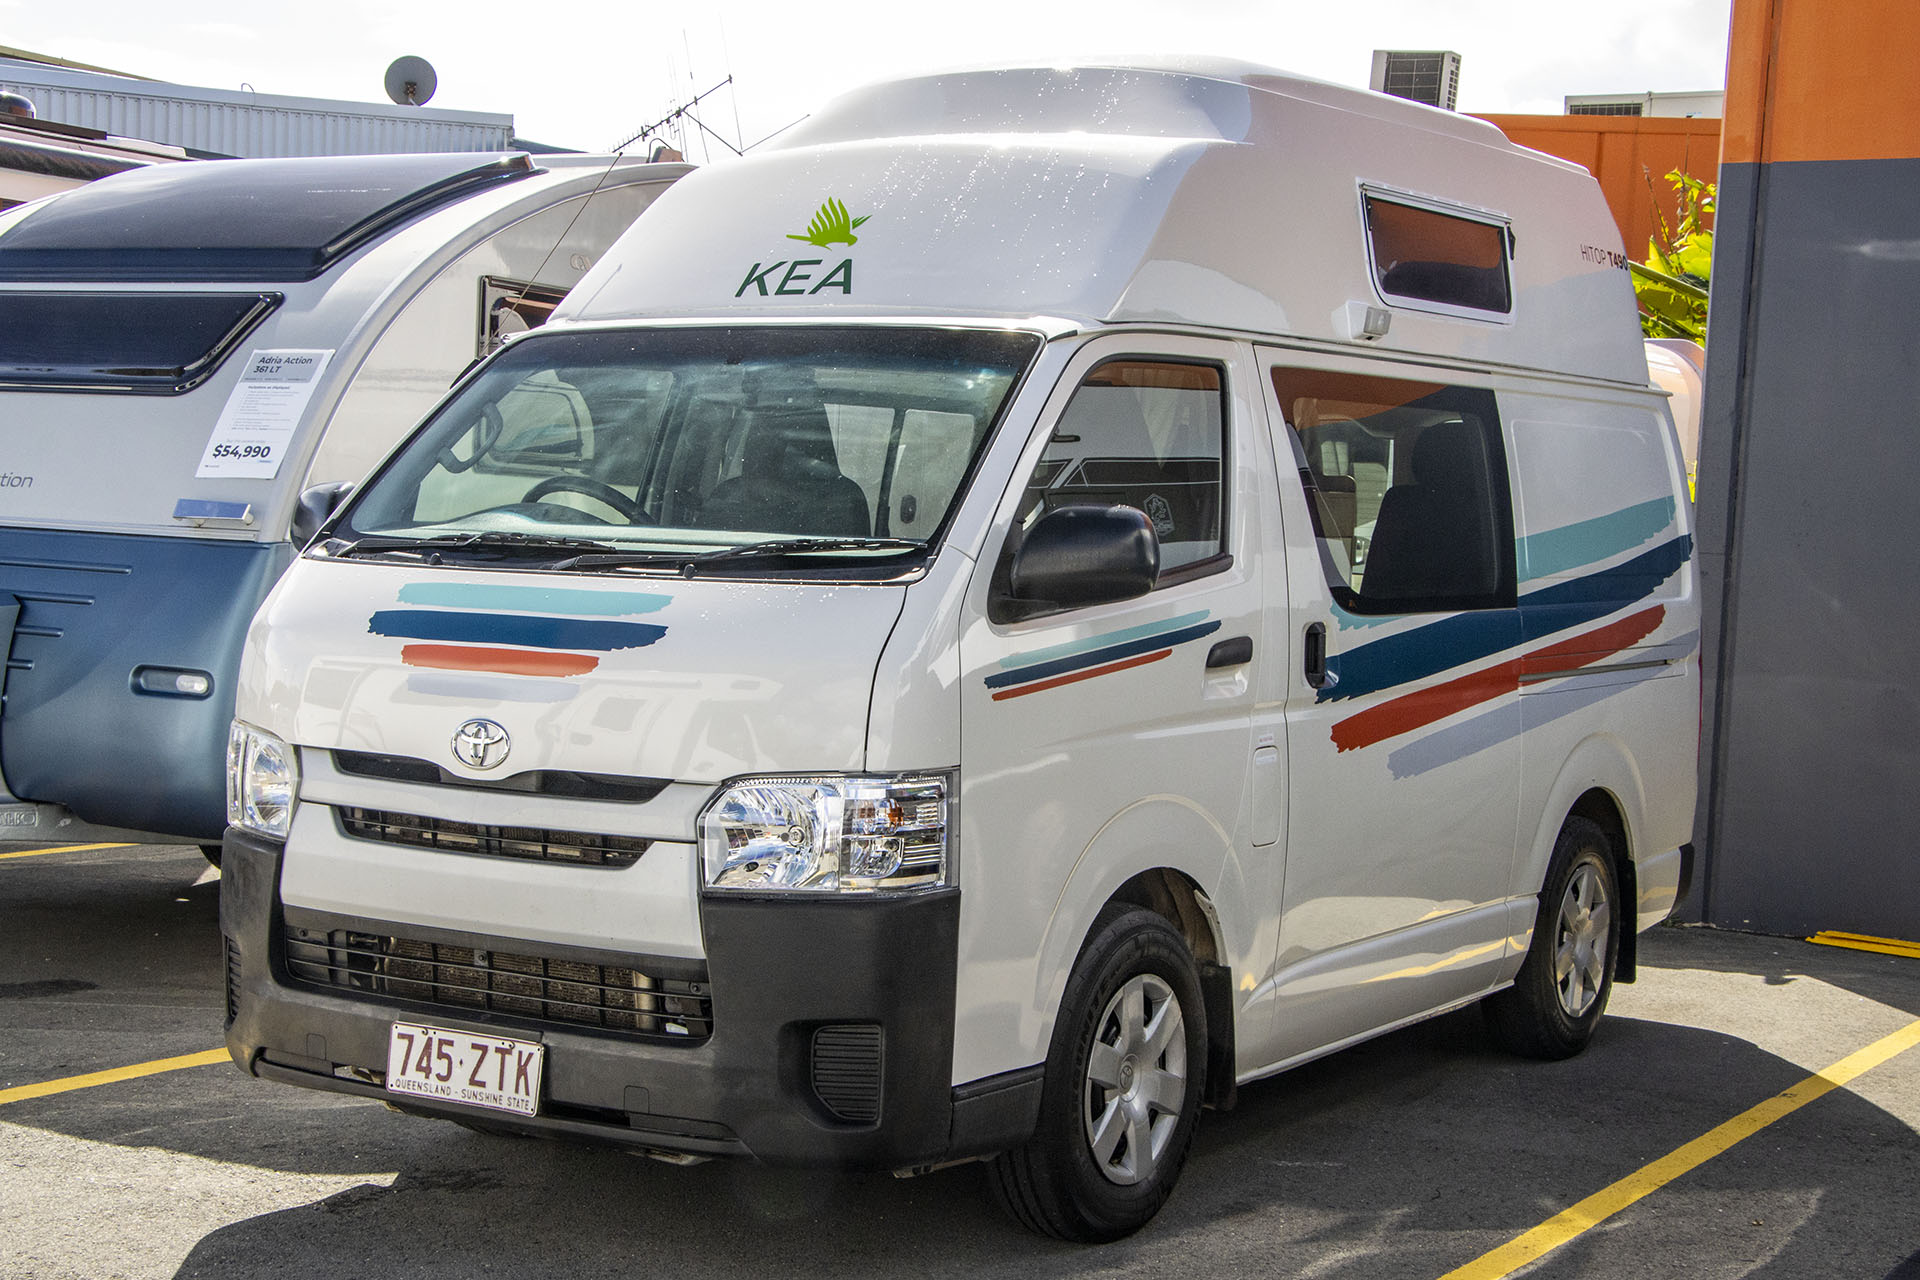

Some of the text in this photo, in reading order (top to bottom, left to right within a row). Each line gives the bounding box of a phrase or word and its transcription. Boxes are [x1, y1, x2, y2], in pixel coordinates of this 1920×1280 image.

[1580, 244, 1628, 271] HITOP T490
[735, 258, 853, 298] KEA
[253, 365, 281, 373] 361 LT
[258, 356, 313, 365] Adria Action
[212, 443, 271, 460] $54,990
[395, 1078, 451, 1097] QUEENSLAND
[461, 1088, 503, 1106] SUNSHINE
[507, 1096, 529, 1111] STATE
